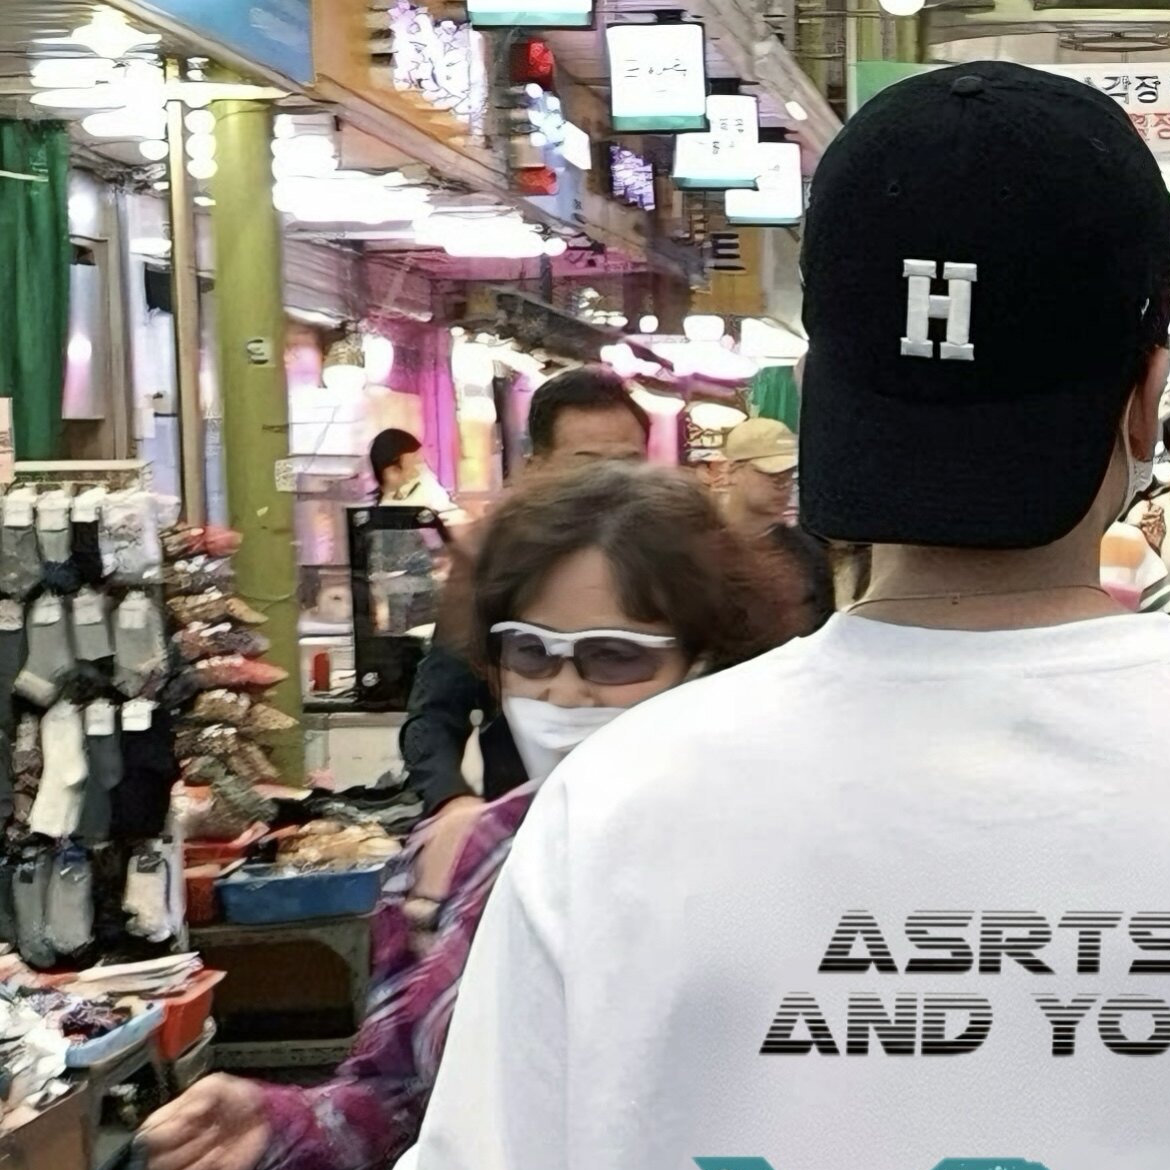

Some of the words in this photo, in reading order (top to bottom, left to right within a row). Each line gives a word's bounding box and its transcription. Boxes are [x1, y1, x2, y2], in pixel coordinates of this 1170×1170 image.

[1084, 75, 1161, 104] 각장
[900, 259, 978, 361] H
[759, 992, 993, 1057] AND
